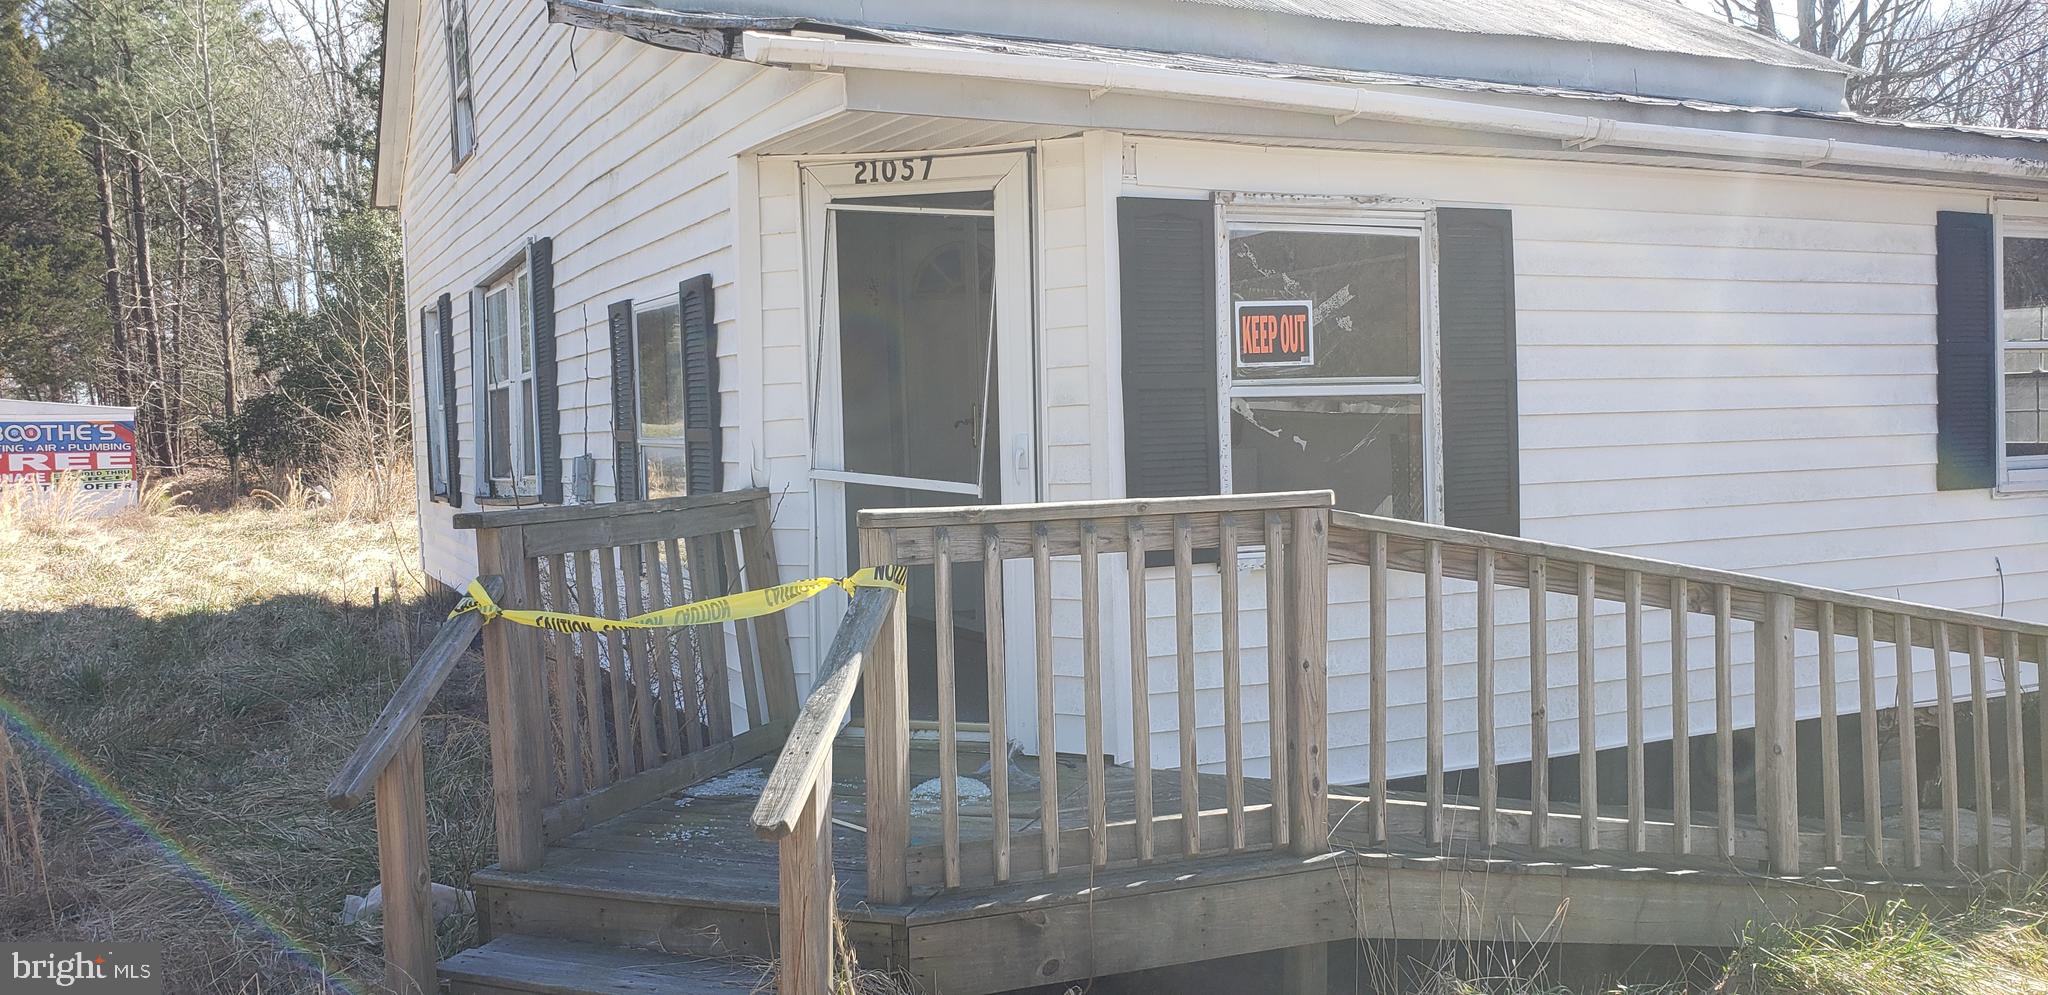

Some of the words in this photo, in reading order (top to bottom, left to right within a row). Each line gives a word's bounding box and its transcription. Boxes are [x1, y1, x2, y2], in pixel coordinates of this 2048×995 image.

[855, 156, 933, 184] 21057
[1242, 315, 1278, 354] KEEP
[1280, 314, 1306, 353] OUT
[0, 424, 116, 442] OOTHE'S
[0, 444, 24, 453] ING
[36, 444, 57, 452] AIR
[68, 442, 131, 452] PLUMBING
[0, 452, 133, 472] REE
[84, 482, 132, 491] OFFER
[536, 615, 592, 633] CAUTION
